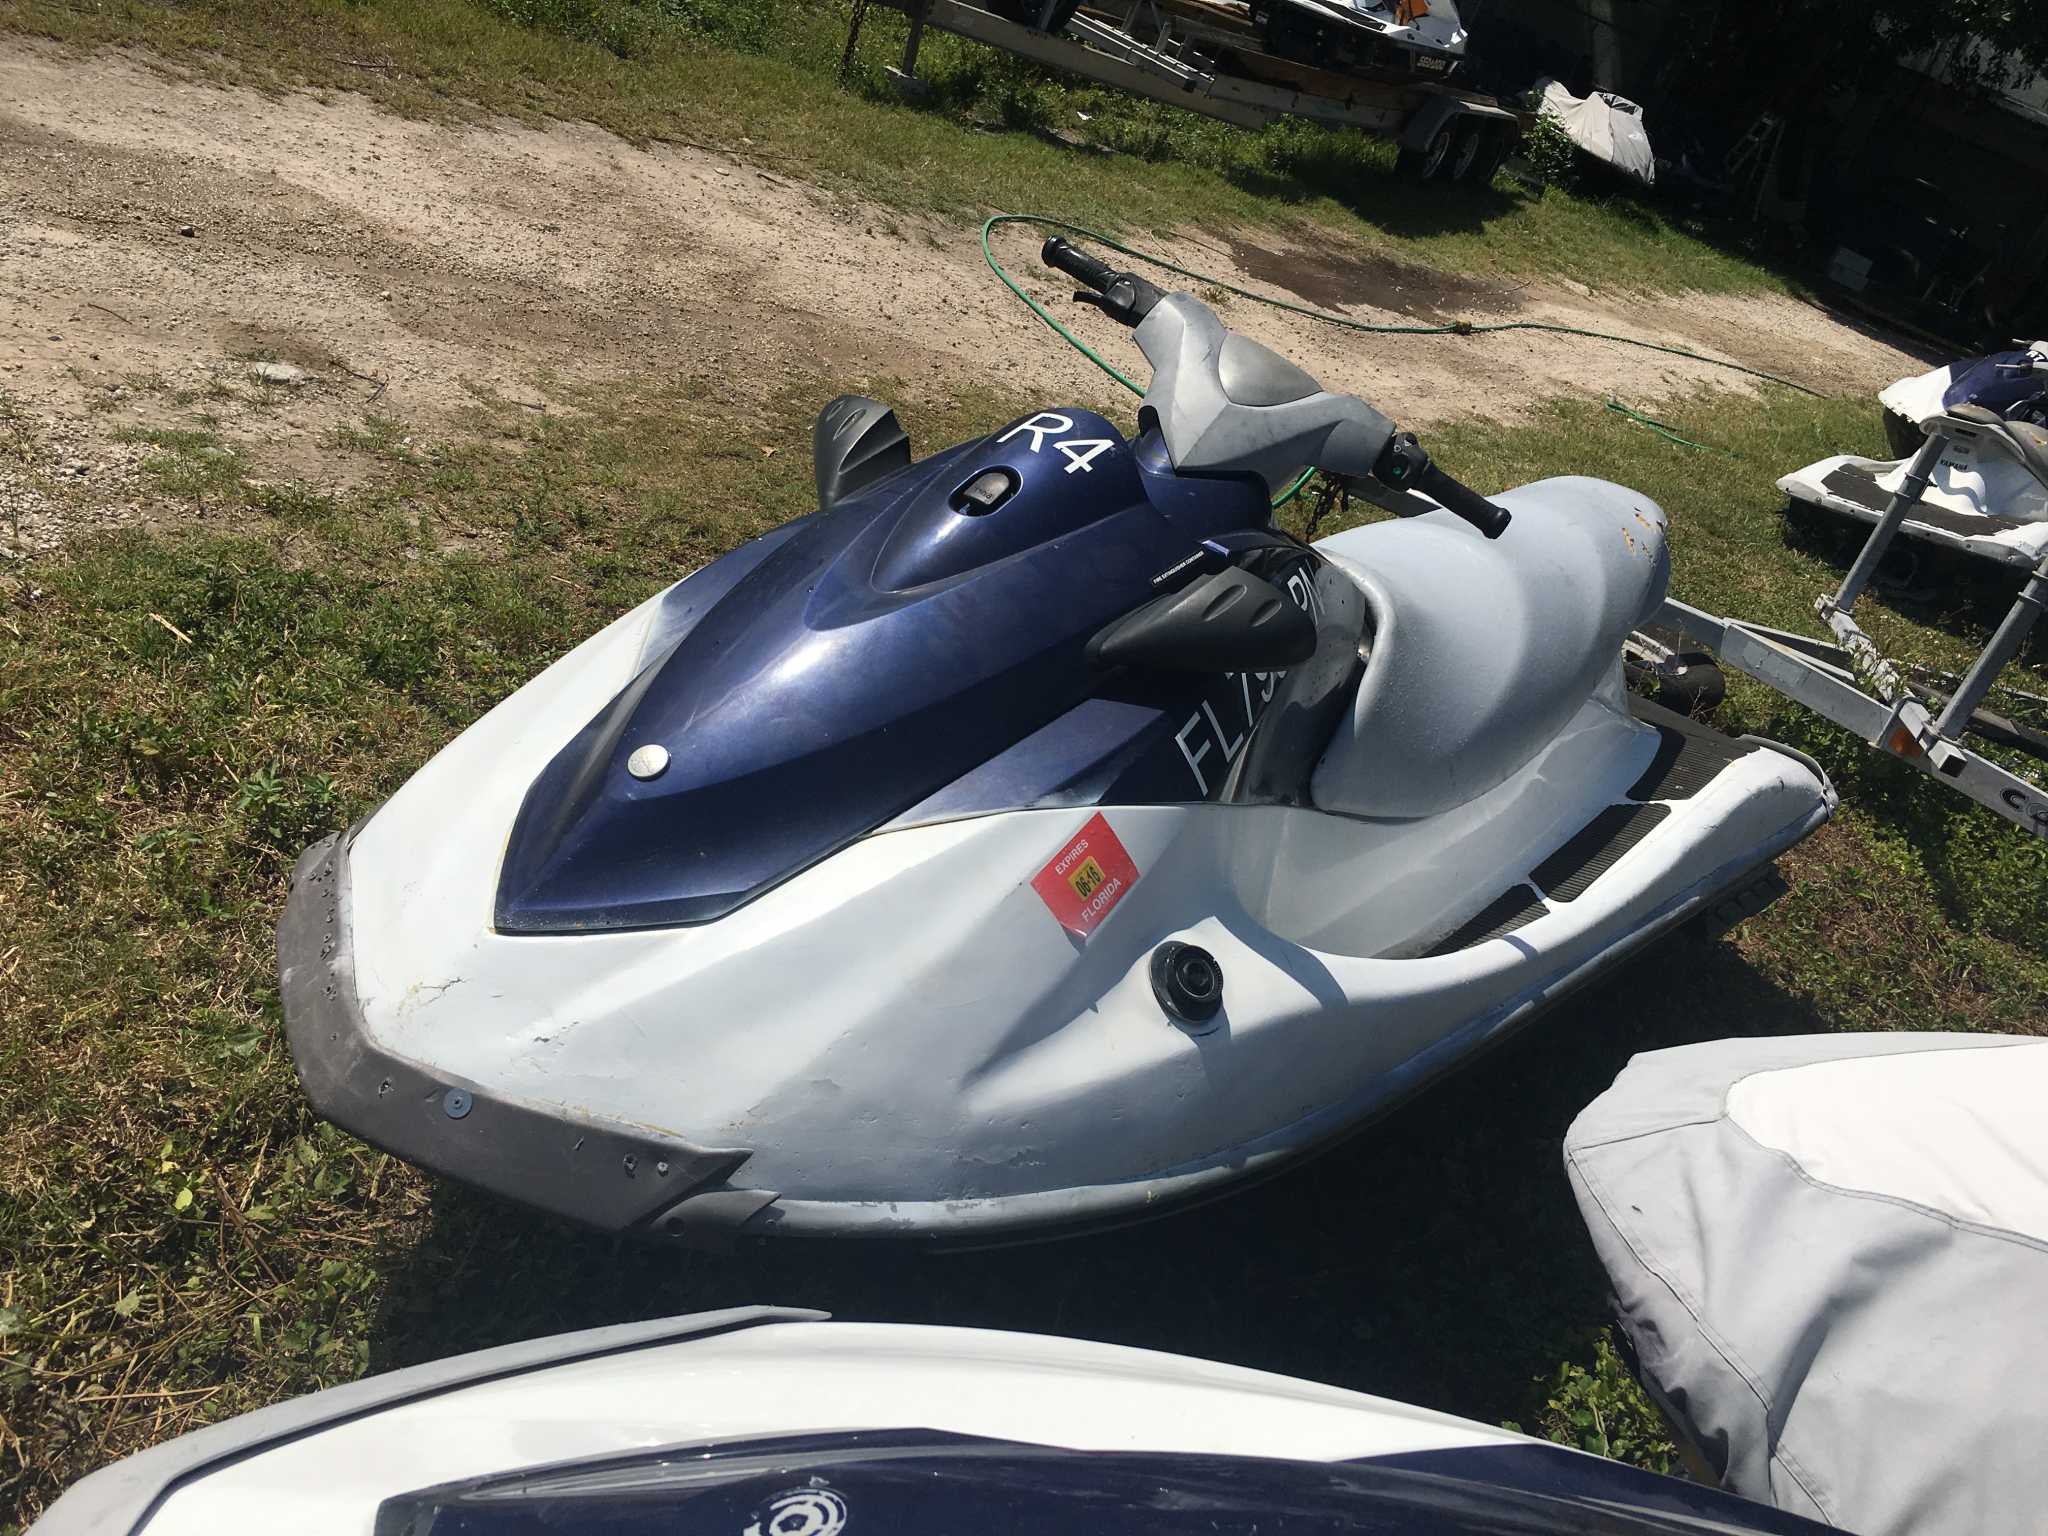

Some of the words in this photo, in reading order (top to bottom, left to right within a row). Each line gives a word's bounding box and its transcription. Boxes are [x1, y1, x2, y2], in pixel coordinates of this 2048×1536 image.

[996, 412, 1115, 475] R4
[1055, 838, 1089, 875] EXPIRES
[1081, 877, 1122, 922] FLORIDA
